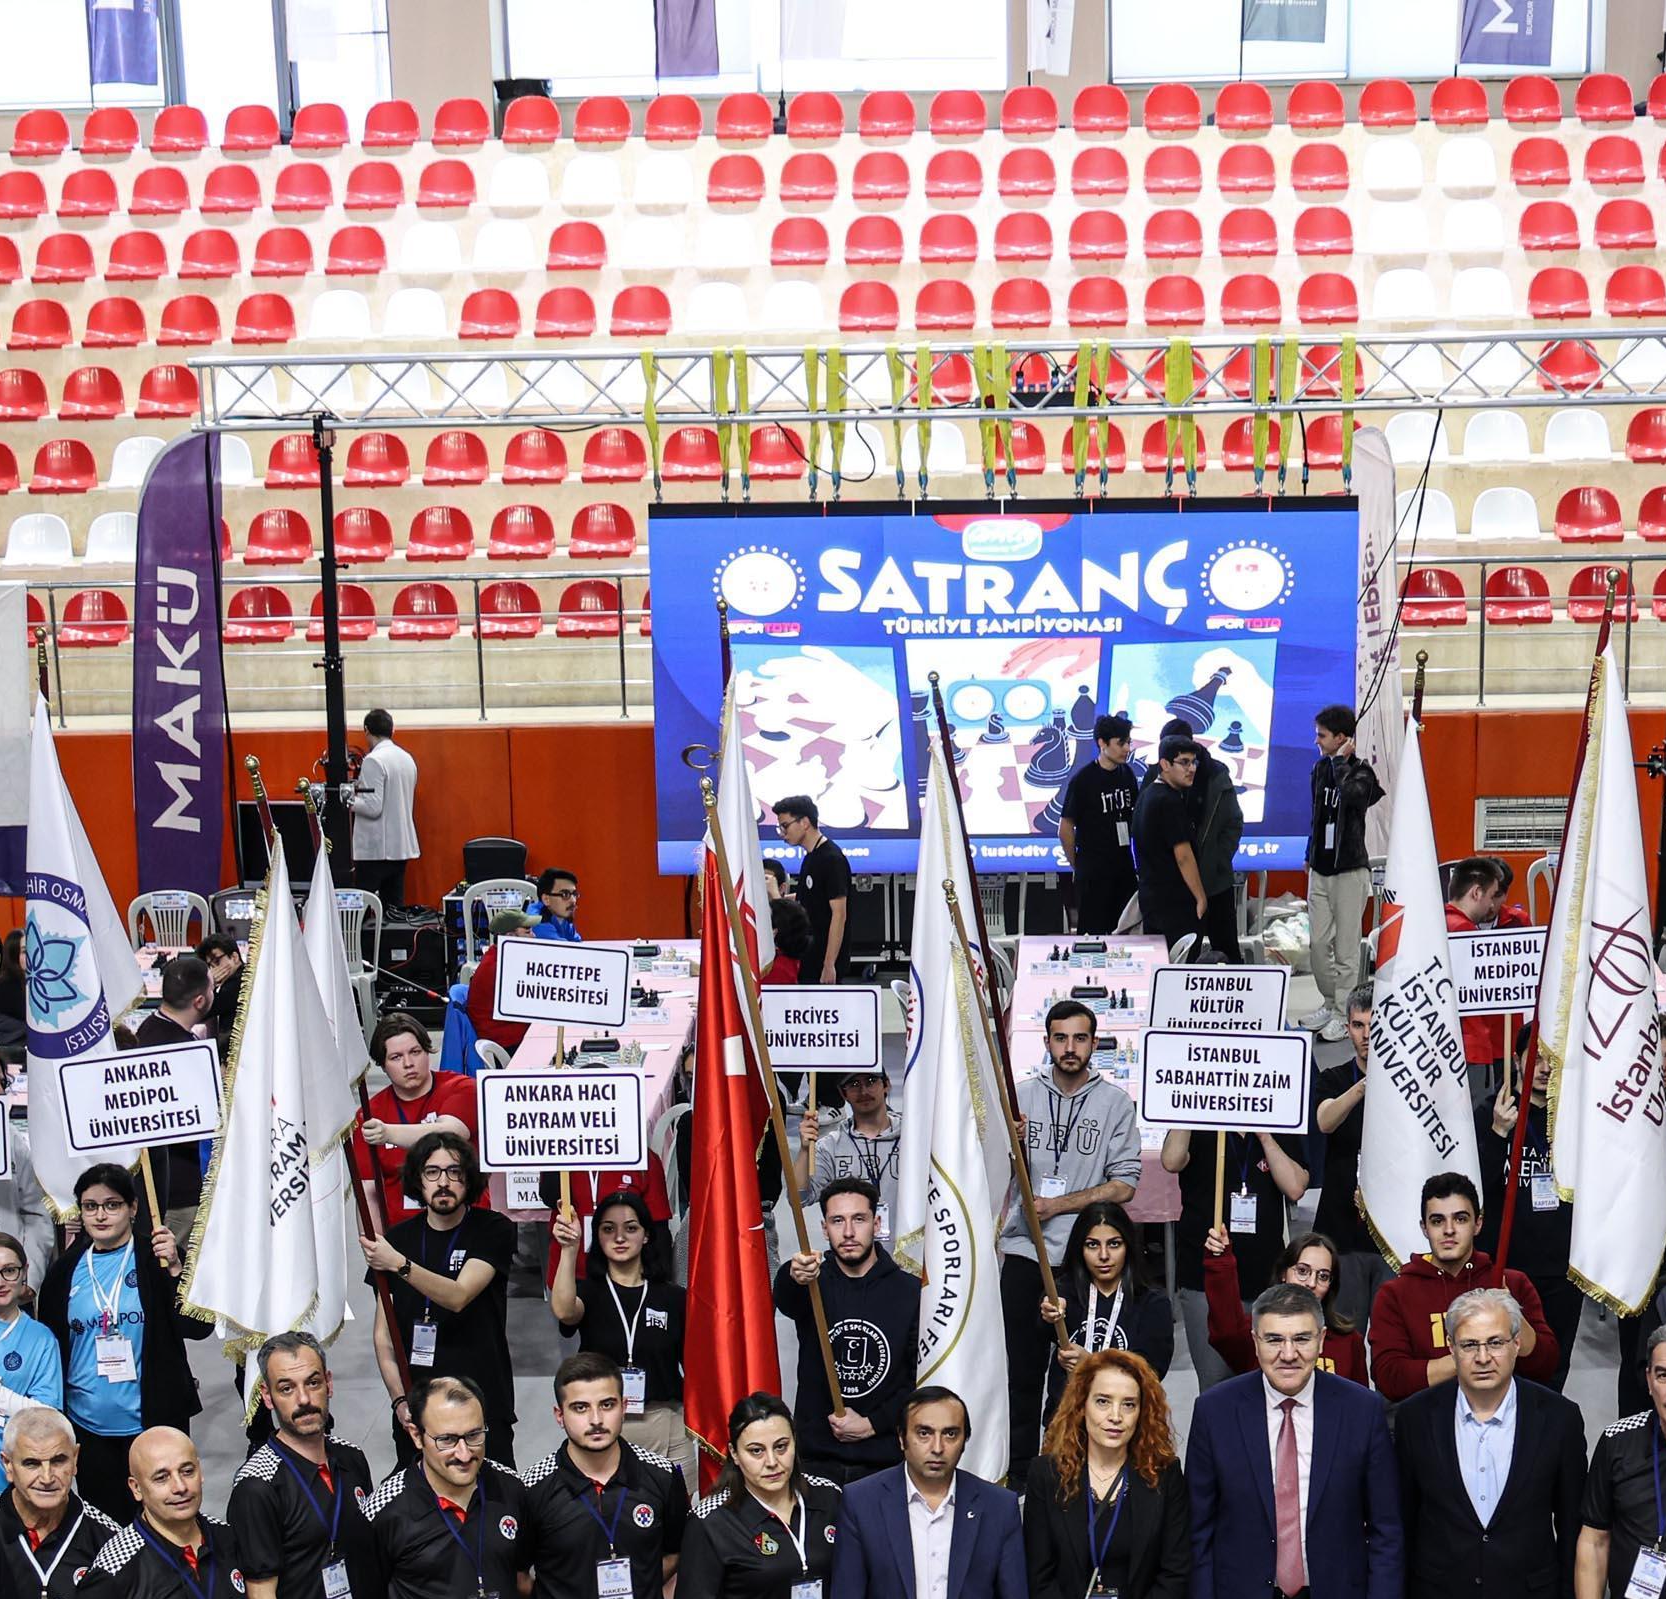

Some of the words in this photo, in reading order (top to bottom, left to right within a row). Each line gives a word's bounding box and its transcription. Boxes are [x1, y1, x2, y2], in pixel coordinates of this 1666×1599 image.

[817, 539, 1189, 627] SATRANÇ
[883, 615, 972, 635] TÜRKİYE
[975, 615, 1124, 637] ŞAMPİYONASI
[152, 566, 201, 833] MAKÜ
[1471, 940, 1541, 958] İSTANBUL
[526, 962, 601, 982] HACETTEPE
[1424, 955, 1454, 1005] T.C.
[1474, 961, 1539, 980] MEDİPOL
[516, 980, 608, 1006] ÜNİVERSİTESİ
[1184, 973, 1253, 991] İSTANBUL
[784, 1006, 839, 1024] ERCİYES
[1190, 996, 1245, 1013] KÜLTÜR
[765, 1029, 860, 1048] ÜNİVERSİTESİ
[1377, 993, 1444, 1087] KÜLTÜR
[1399, 973, 1467, 1088] İSTANBUL
[1187, 1043, 1261, 1064] İSTANBUL
[104, 1060, 171, 1085] ANKARA
[1155, 1068, 1249, 1089] SABAHATTİN
[1253, 1070, 1290, 1090] ZAİM
[505, 1084, 574, 1102] ANKARA
[578, 1083, 616, 1101] HACI
[1369, 1010, 1459, 1161] ÜNİVERSİTESİ
[104, 1086, 178, 1111] MEDİPOL
[1172, 1090, 1273, 1112] ÜNİVERSİTESİ
[89, 1104, 201, 1139] ÜNİVERSİTESİ
[506, 1112, 576, 1129] BAYRAM
[580, 1107, 616, 1129] VELİ
[505, 1135, 619, 1156] ÜNİVERSİTESİ
[1029, 1119, 1100, 1155] ERÜ
[933, 1207, 961, 1327] SPORLARI
[601, 1587, 627, 1595] HAKEM
